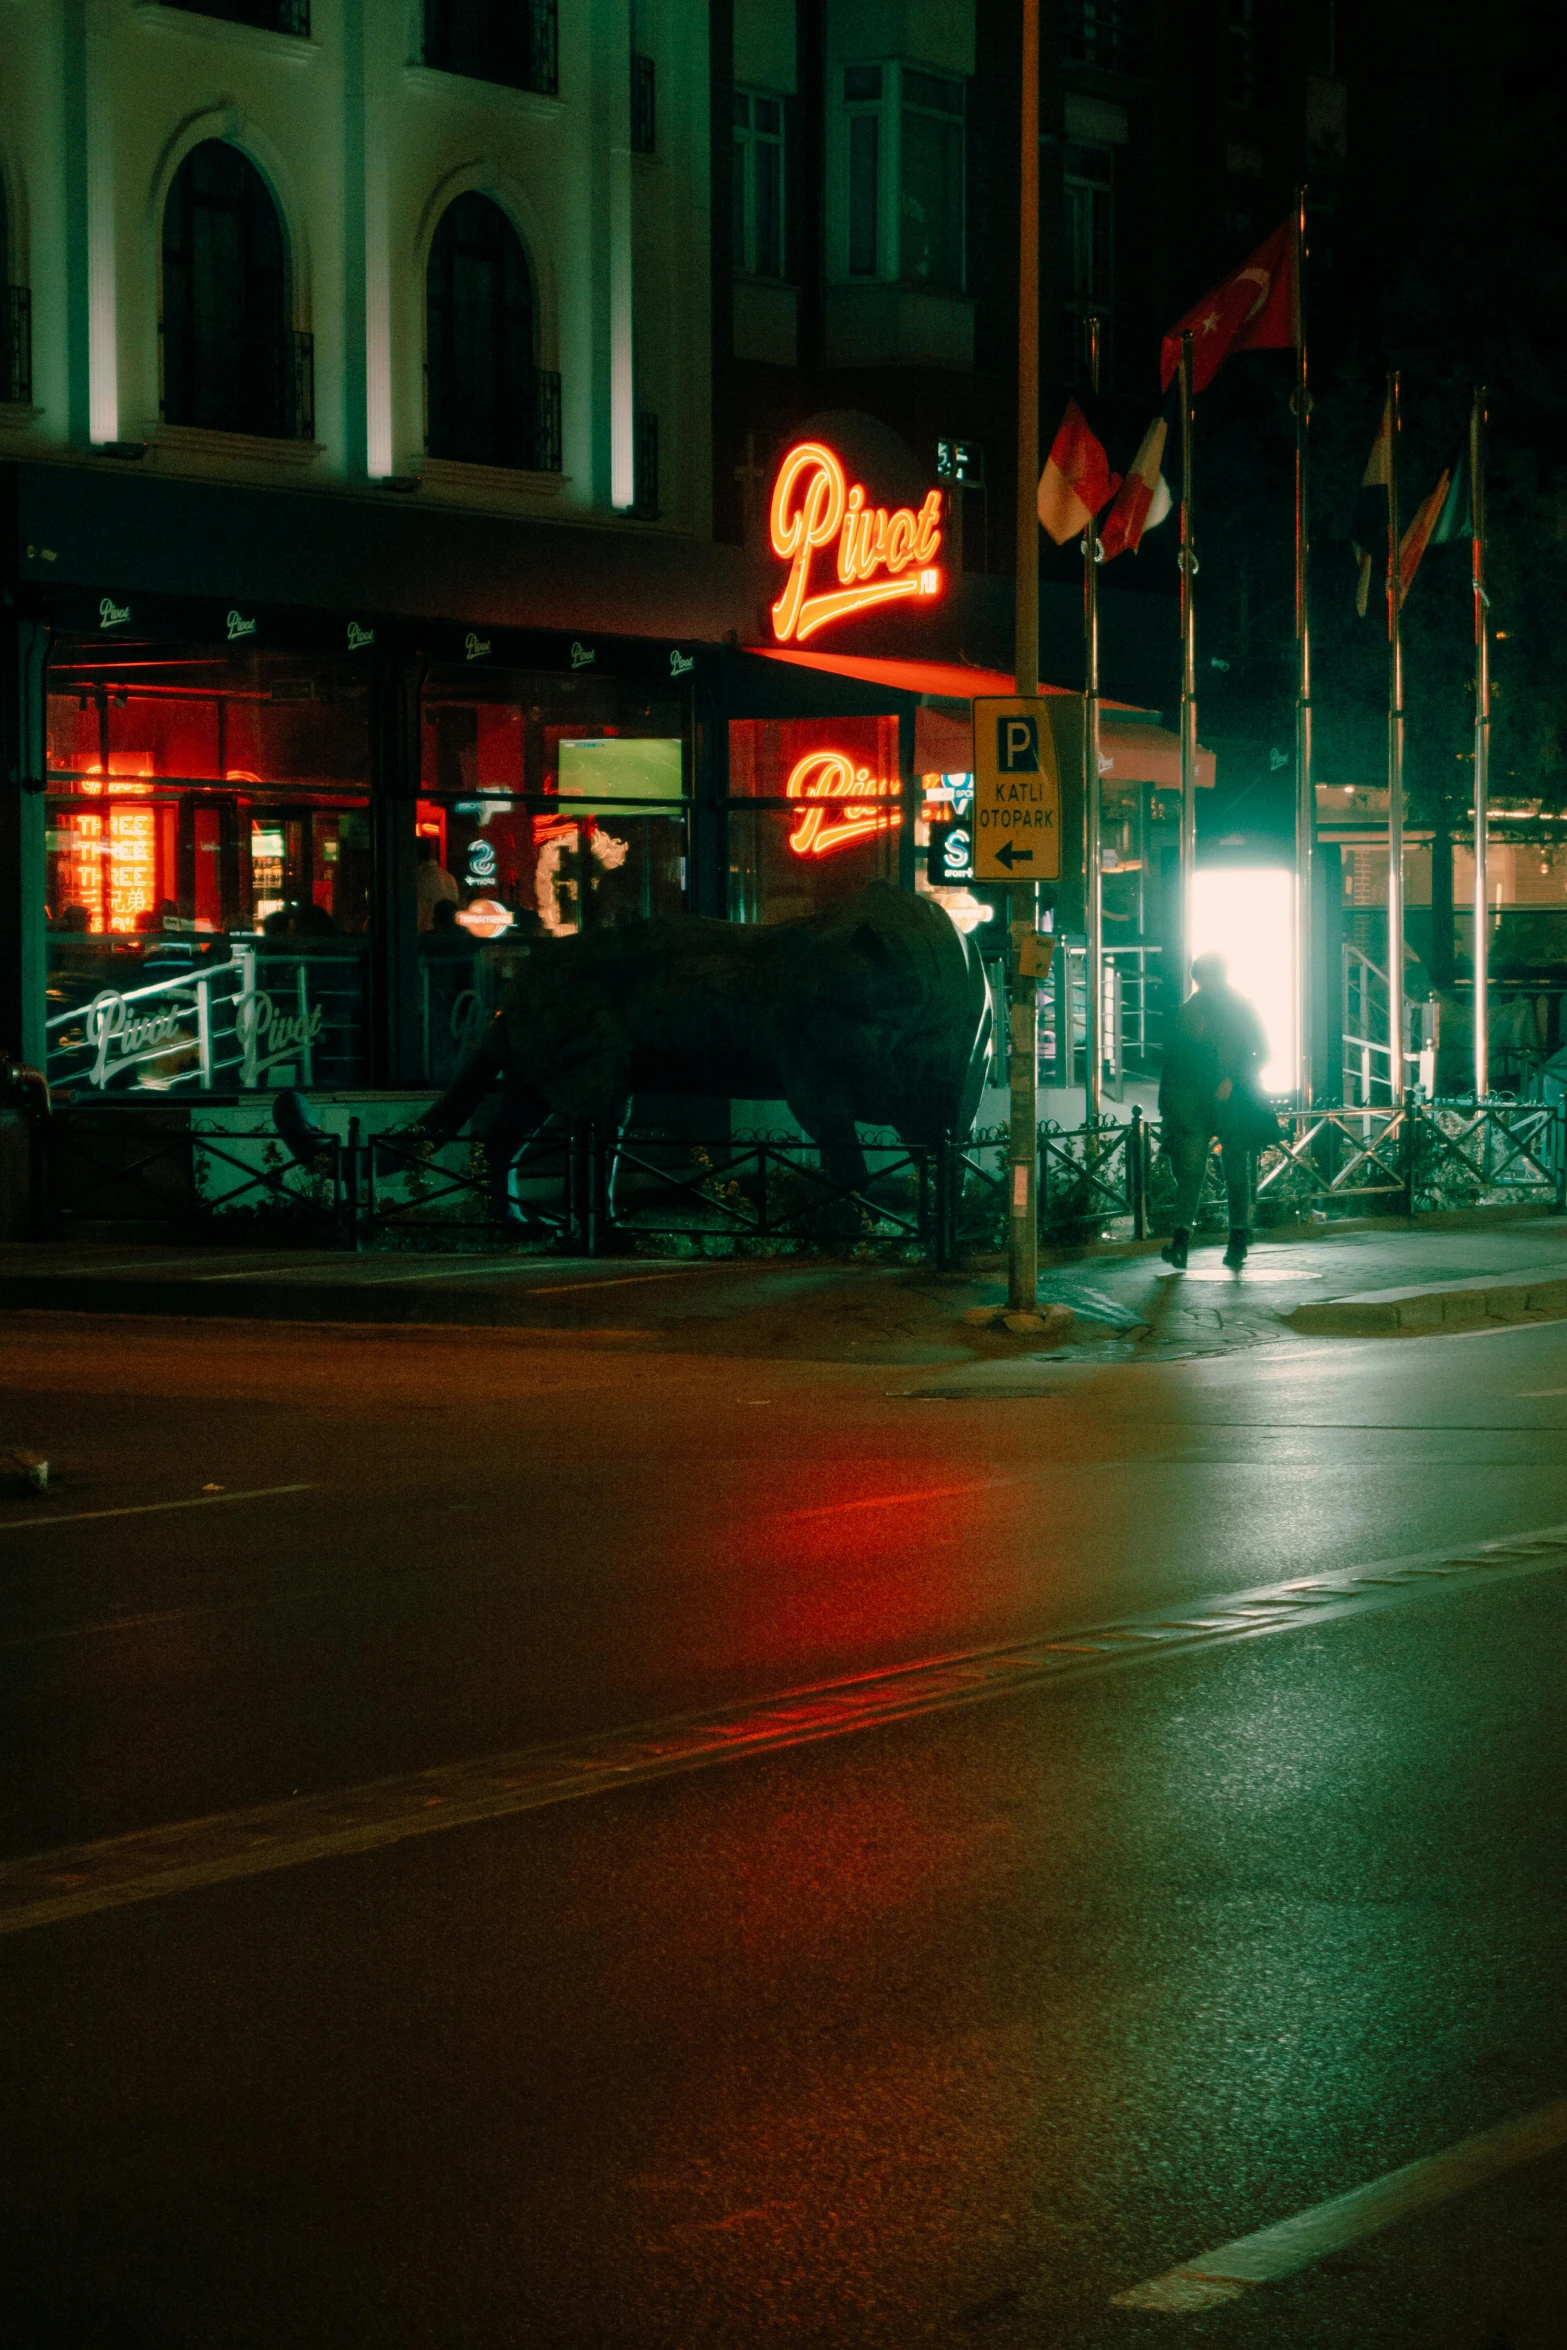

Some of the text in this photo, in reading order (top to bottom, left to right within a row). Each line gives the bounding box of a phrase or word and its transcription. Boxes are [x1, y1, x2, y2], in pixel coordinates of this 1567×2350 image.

[770, 443, 942, 641] Pivot
[100, 598, 129, 627] Pivot
[227, 610, 255, 639] Pivot
[348, 622, 374, 649] Pivot
[465, 632, 491, 660] Pivot
[571, 642, 595, 668] Pivot
[670, 650, 693, 676] Pivot
[1006, 723, 1030, 766] P
[996, 784, 1042, 801] KATLI
[77, 816, 148, 836] THREE
[980, 810, 1053, 828] OTOPARK
[77, 841, 148, 861] THREE
[77, 867, 147, 887] THREE
[86, 989, 180, 1085] Pivot
[236, 990, 322, 1086] Pivot
